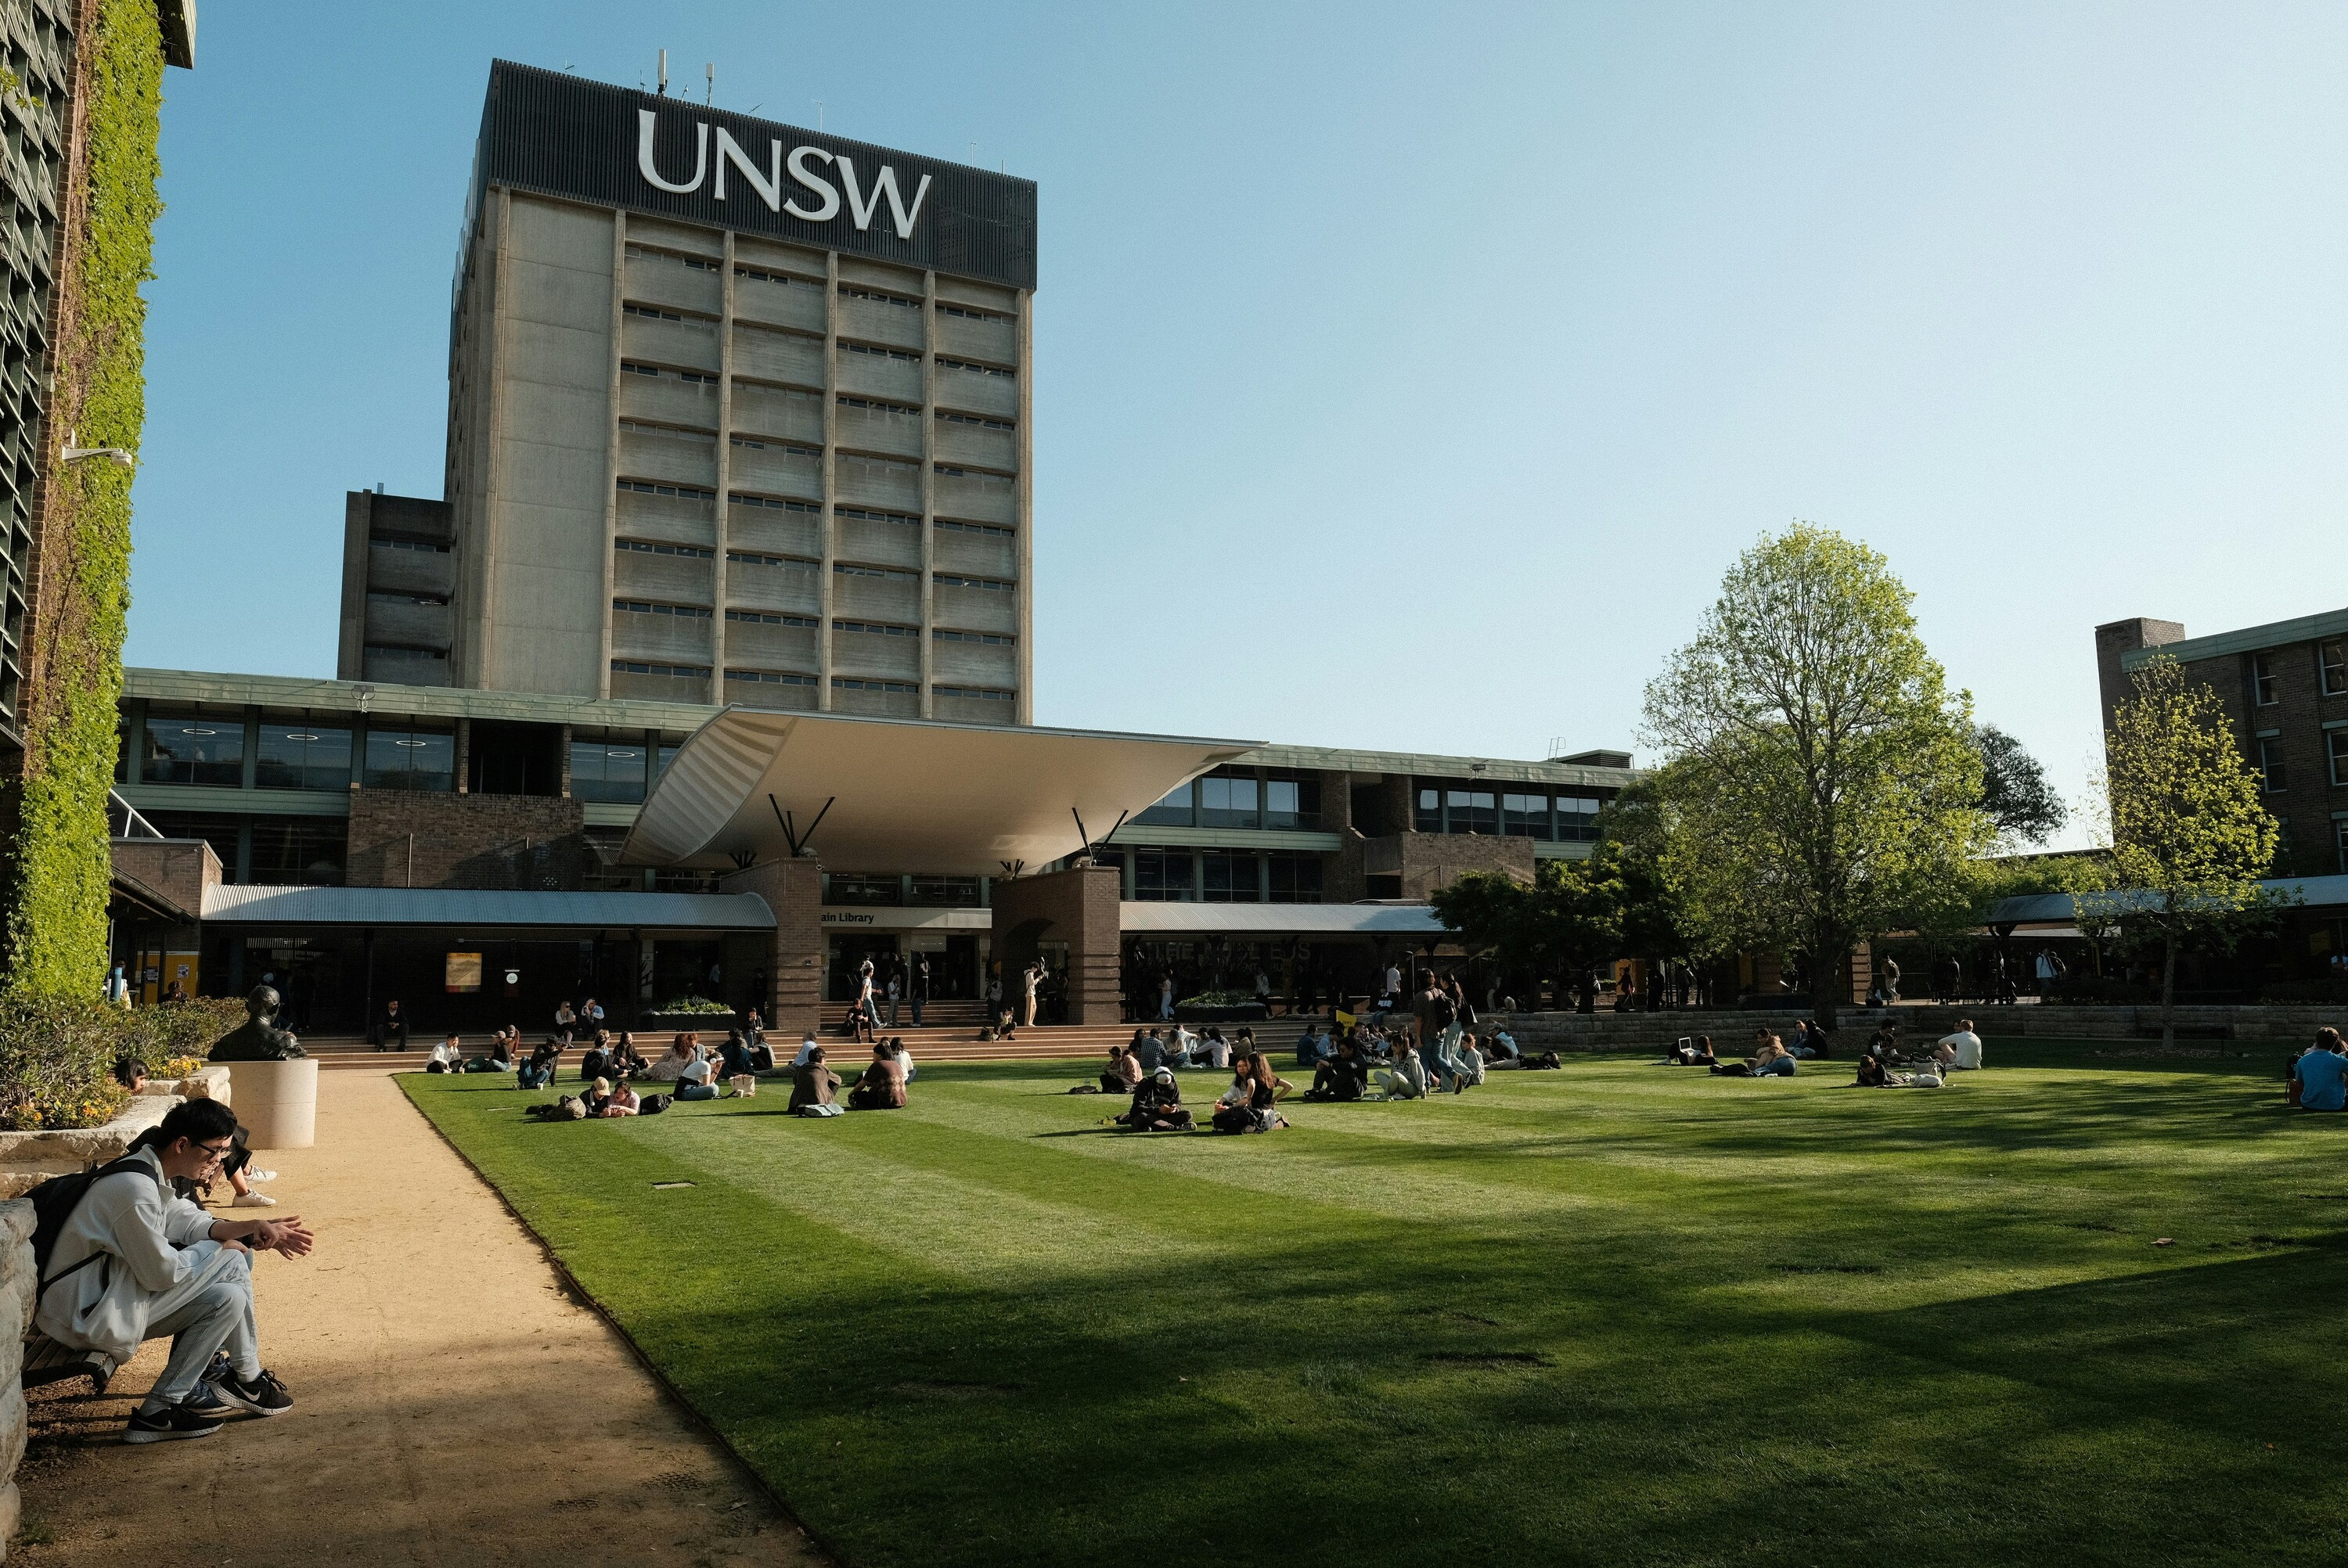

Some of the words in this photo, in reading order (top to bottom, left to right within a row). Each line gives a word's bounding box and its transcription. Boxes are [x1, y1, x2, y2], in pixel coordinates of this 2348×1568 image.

[638, 109, 932, 239] UNSW
[821, 912, 836, 922] ain
[839, 912, 874, 924] Library
